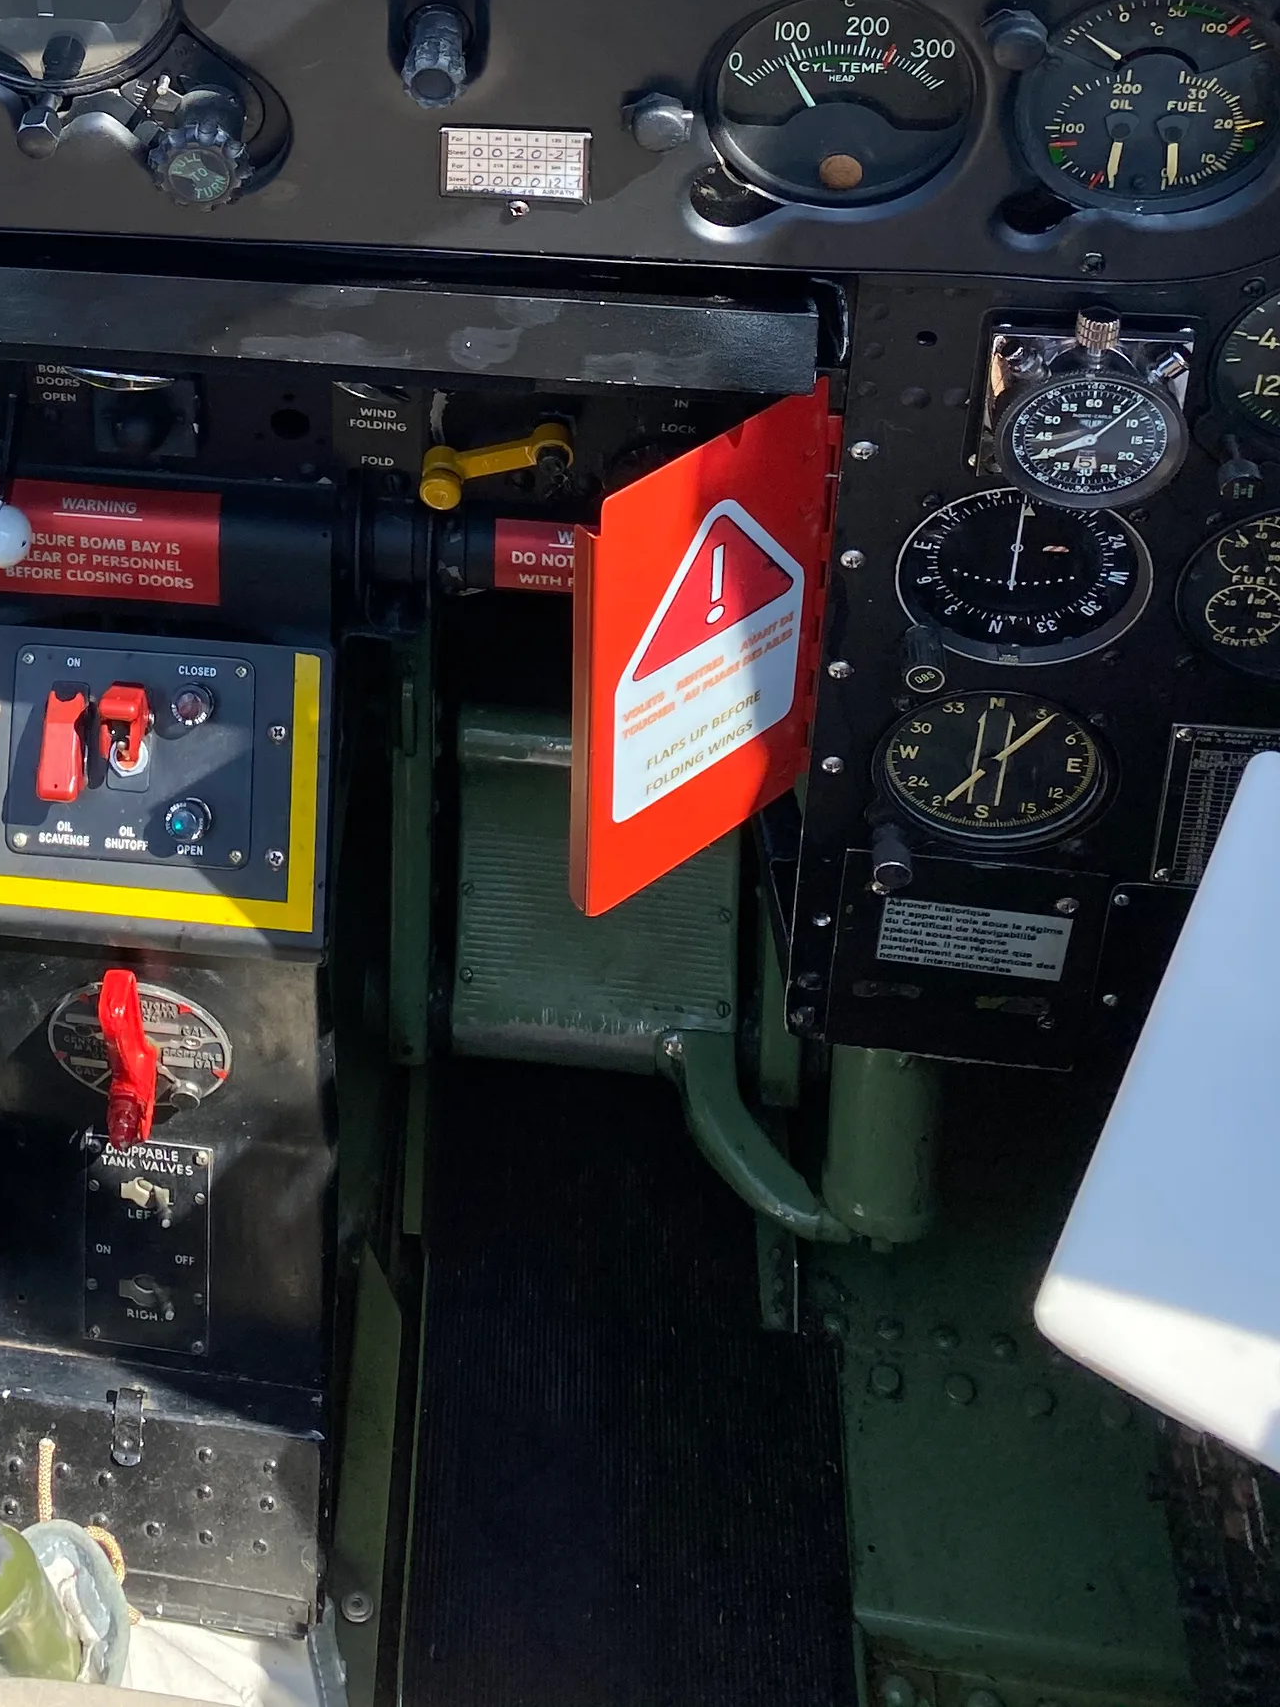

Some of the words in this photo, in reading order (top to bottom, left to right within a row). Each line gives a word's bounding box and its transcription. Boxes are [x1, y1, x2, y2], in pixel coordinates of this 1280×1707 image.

[775, 22, 810, 41] 100
[846, 17, 889, 36] 200
[910, 39, 955, 58] 300
[729, 53, 743, 71] 0
[1110, 99, 1133, 110] OIL
[1167, 101, 1206, 113] FUEL
[172, 153, 201, 174] PULL
[190, 168, 208, 181] TO
[195, 176, 227, 199] TURN
[36, 376, 80, 387] DOORS
[43, 391, 77, 402] OPEN
[360, 407, 397, 419] WIND
[349, 418, 407, 432] FOLDING
[361, 456, 395, 467] FOLD
[62, 497, 137, 514] WARNING
[80, 536, 126, 551] BOMB
[131, 541, 161, 554] BAY
[165, 543, 181, 555] IS
[66, 552, 87, 565] OF
[92, 555, 182, 572] PERSONNEL
[5, 566, 61, 580] BEFORE
[66, 569, 133, 585] CLOSING
[138, 572, 194, 589] DOORS
[67, 658, 81, 668] ON
[178, 665, 217, 677] CLOSED
[646, 738, 686, 770] FLAPS
[690, 724, 708, 744] UP
[711, 689, 762, 730] BEFORE
[645, 750, 704, 796] FOLDING
[707, 719, 753, 756] WINGS
[57, 821, 73, 832] OIL
[119, 826, 135, 837] OIL
[39, 832, 89, 846] SCAVENGE
[105, 838, 149, 851] SHUTOFF
[177, 845, 203, 856] OPEN
[101, 1154, 136, 1169] TANK
[142, 1160, 193, 1176] VALVES
[95, 1244, 111, 1255] ON
[175, 1254, 195, 1266] OFF
